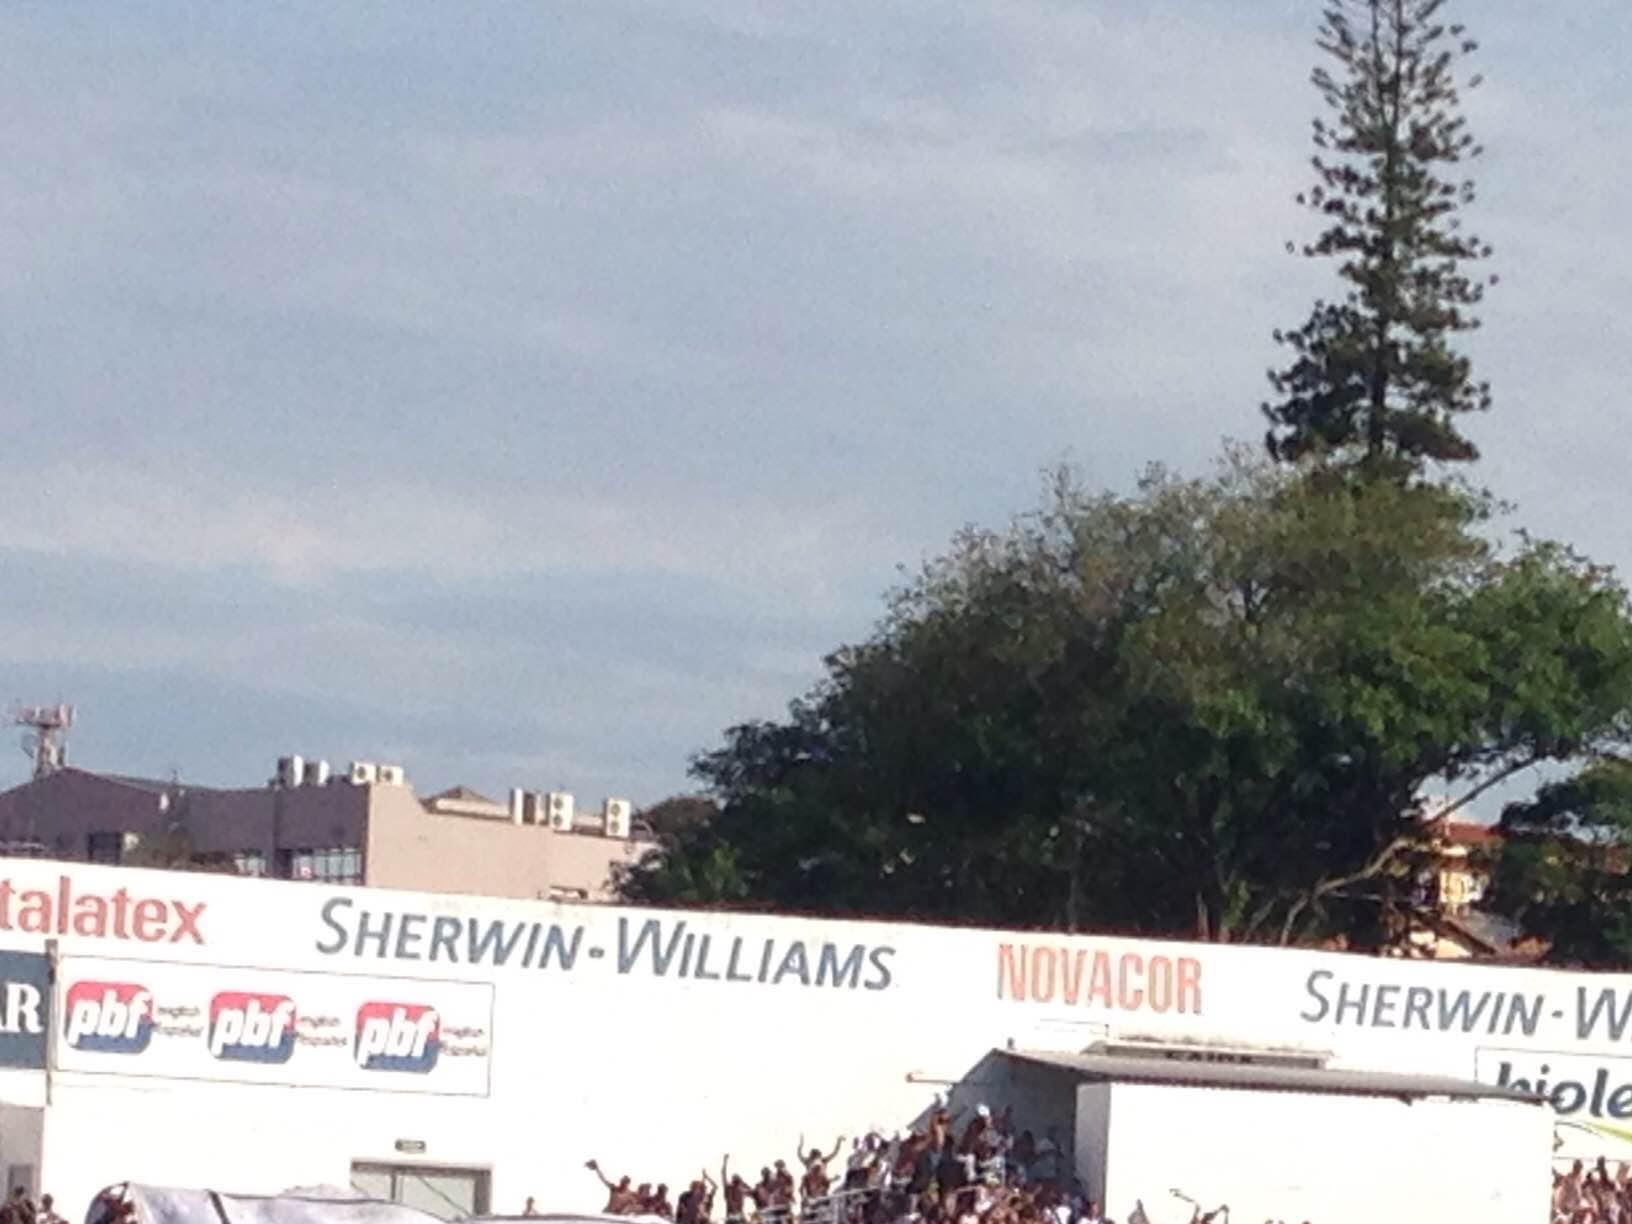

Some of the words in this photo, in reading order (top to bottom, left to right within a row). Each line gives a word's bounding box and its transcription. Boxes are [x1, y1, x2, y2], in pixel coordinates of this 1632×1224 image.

[997, 942, 1203, 1015] NOVACOR
[66, 989, 153, 1047] pbf
[209, 999, 295, 1058] pbf
[357, 1008, 438, 1068] pbf
